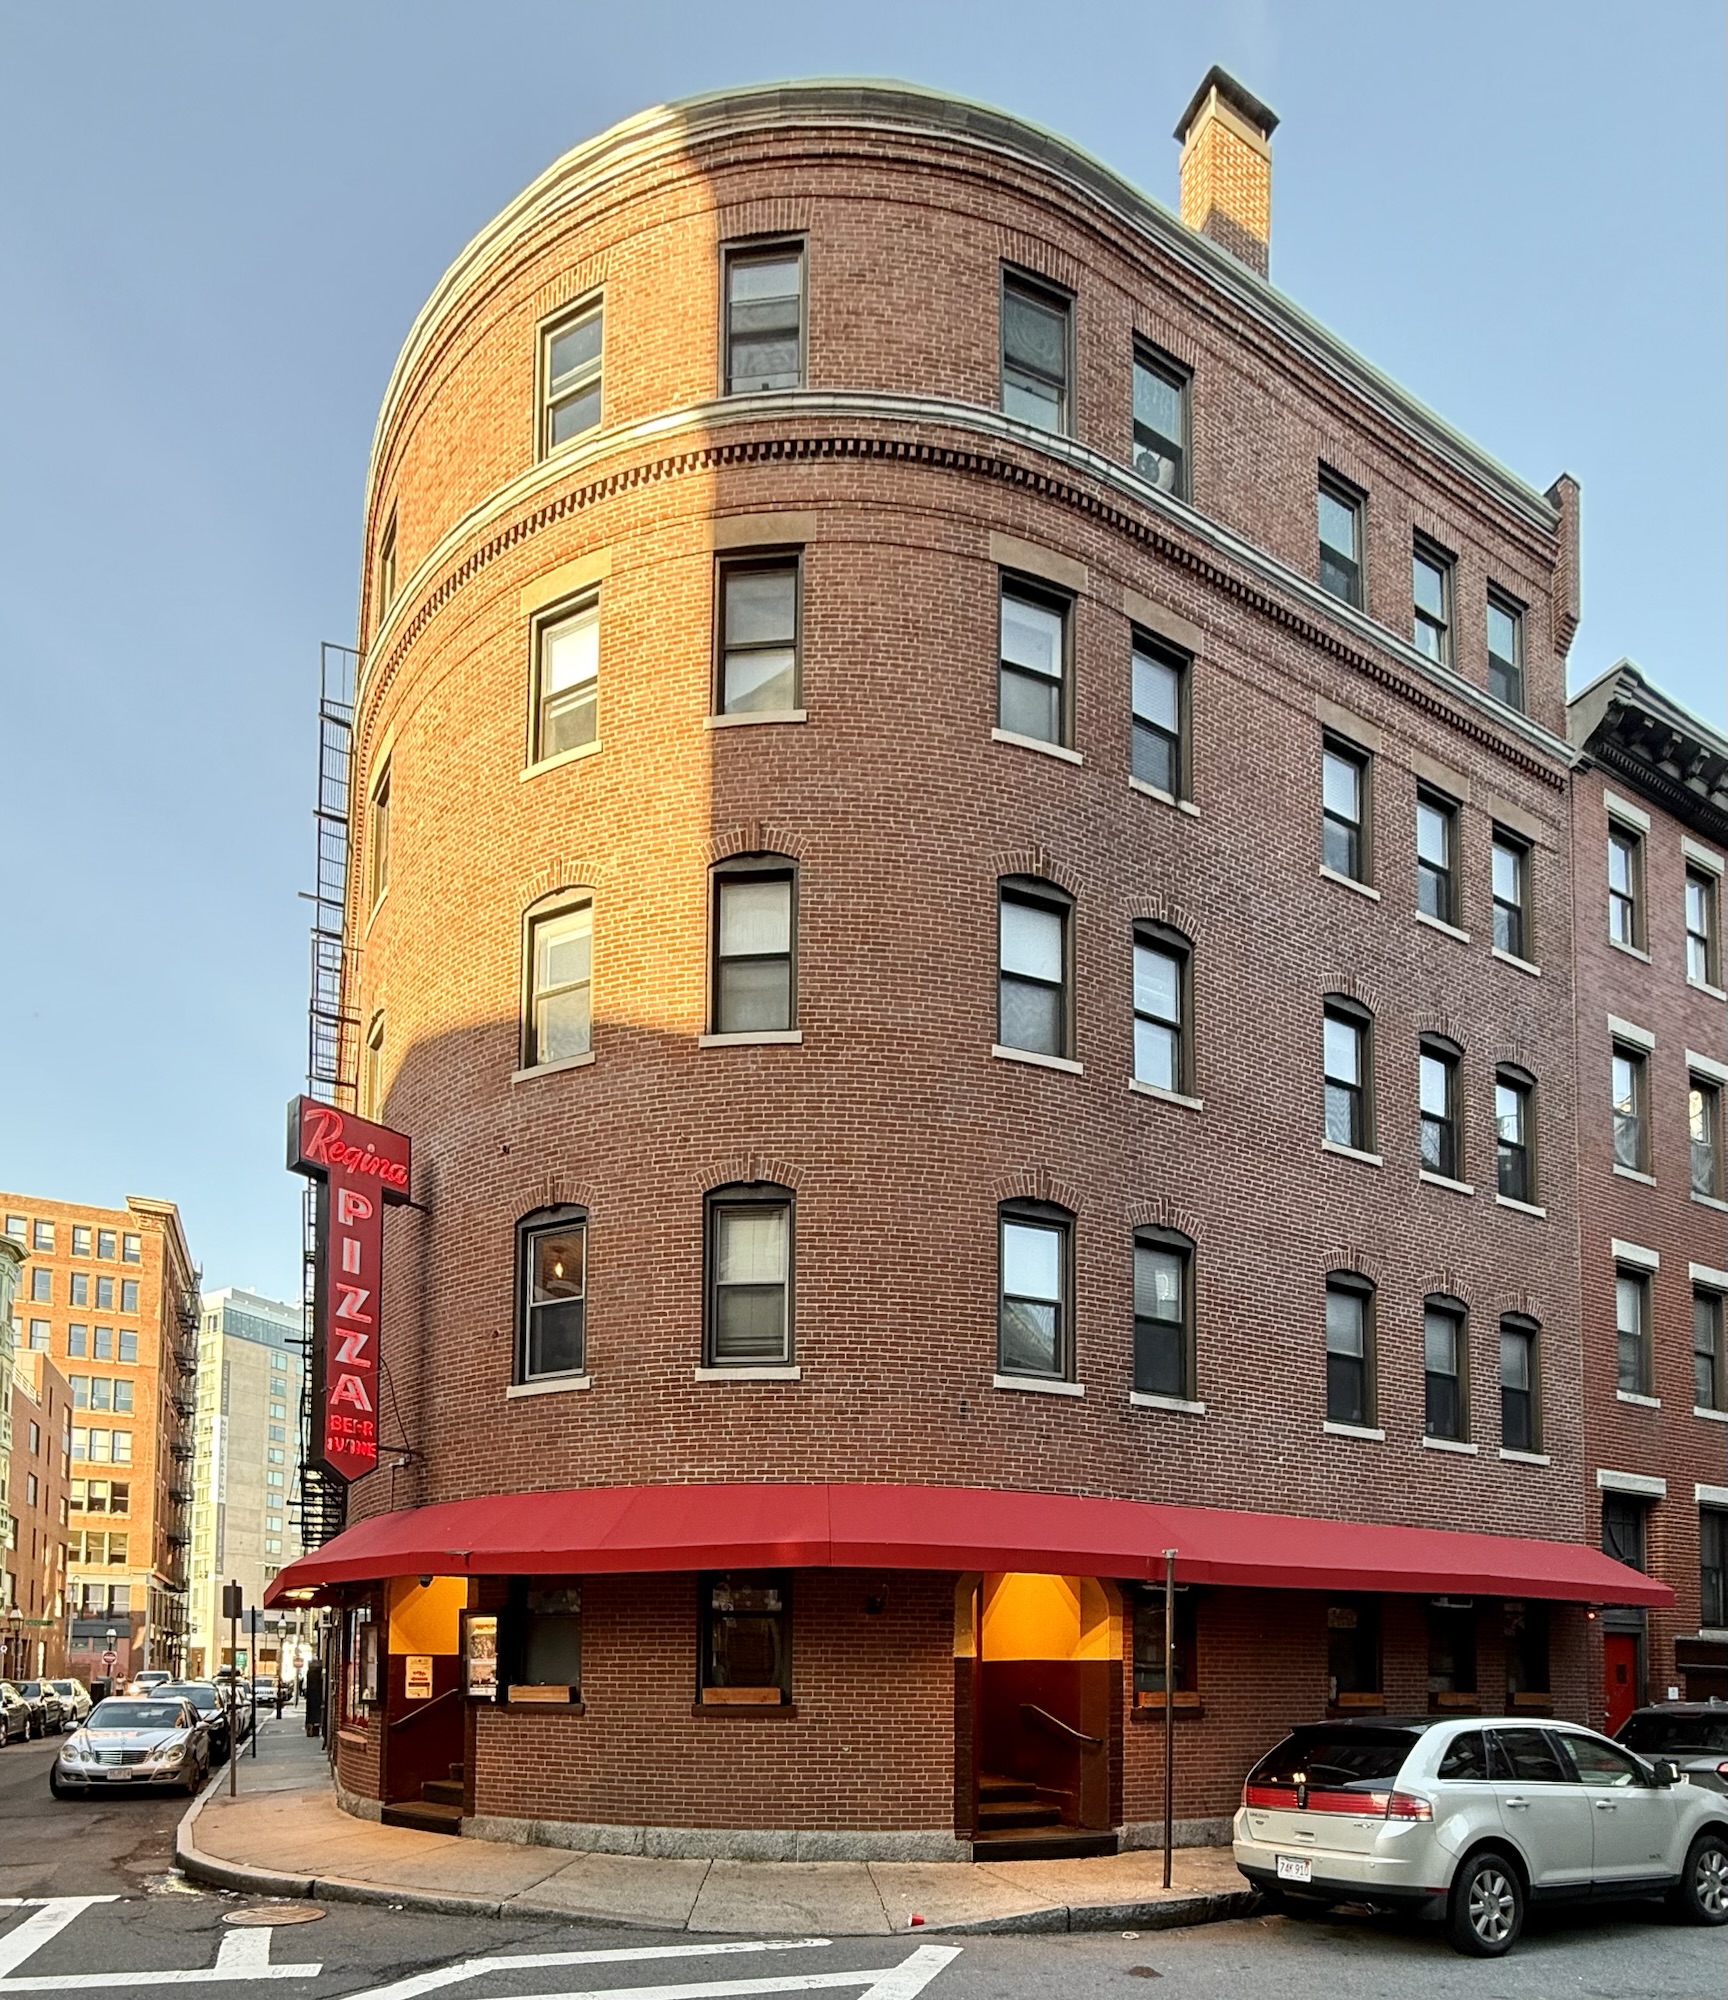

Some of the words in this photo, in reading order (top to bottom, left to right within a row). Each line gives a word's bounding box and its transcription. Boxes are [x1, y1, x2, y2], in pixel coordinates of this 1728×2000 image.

[304, 1108, 408, 1185] Regina
[329, 1187, 373, 1412] PIZZA
[330, 1414, 374, 1436] BEER
